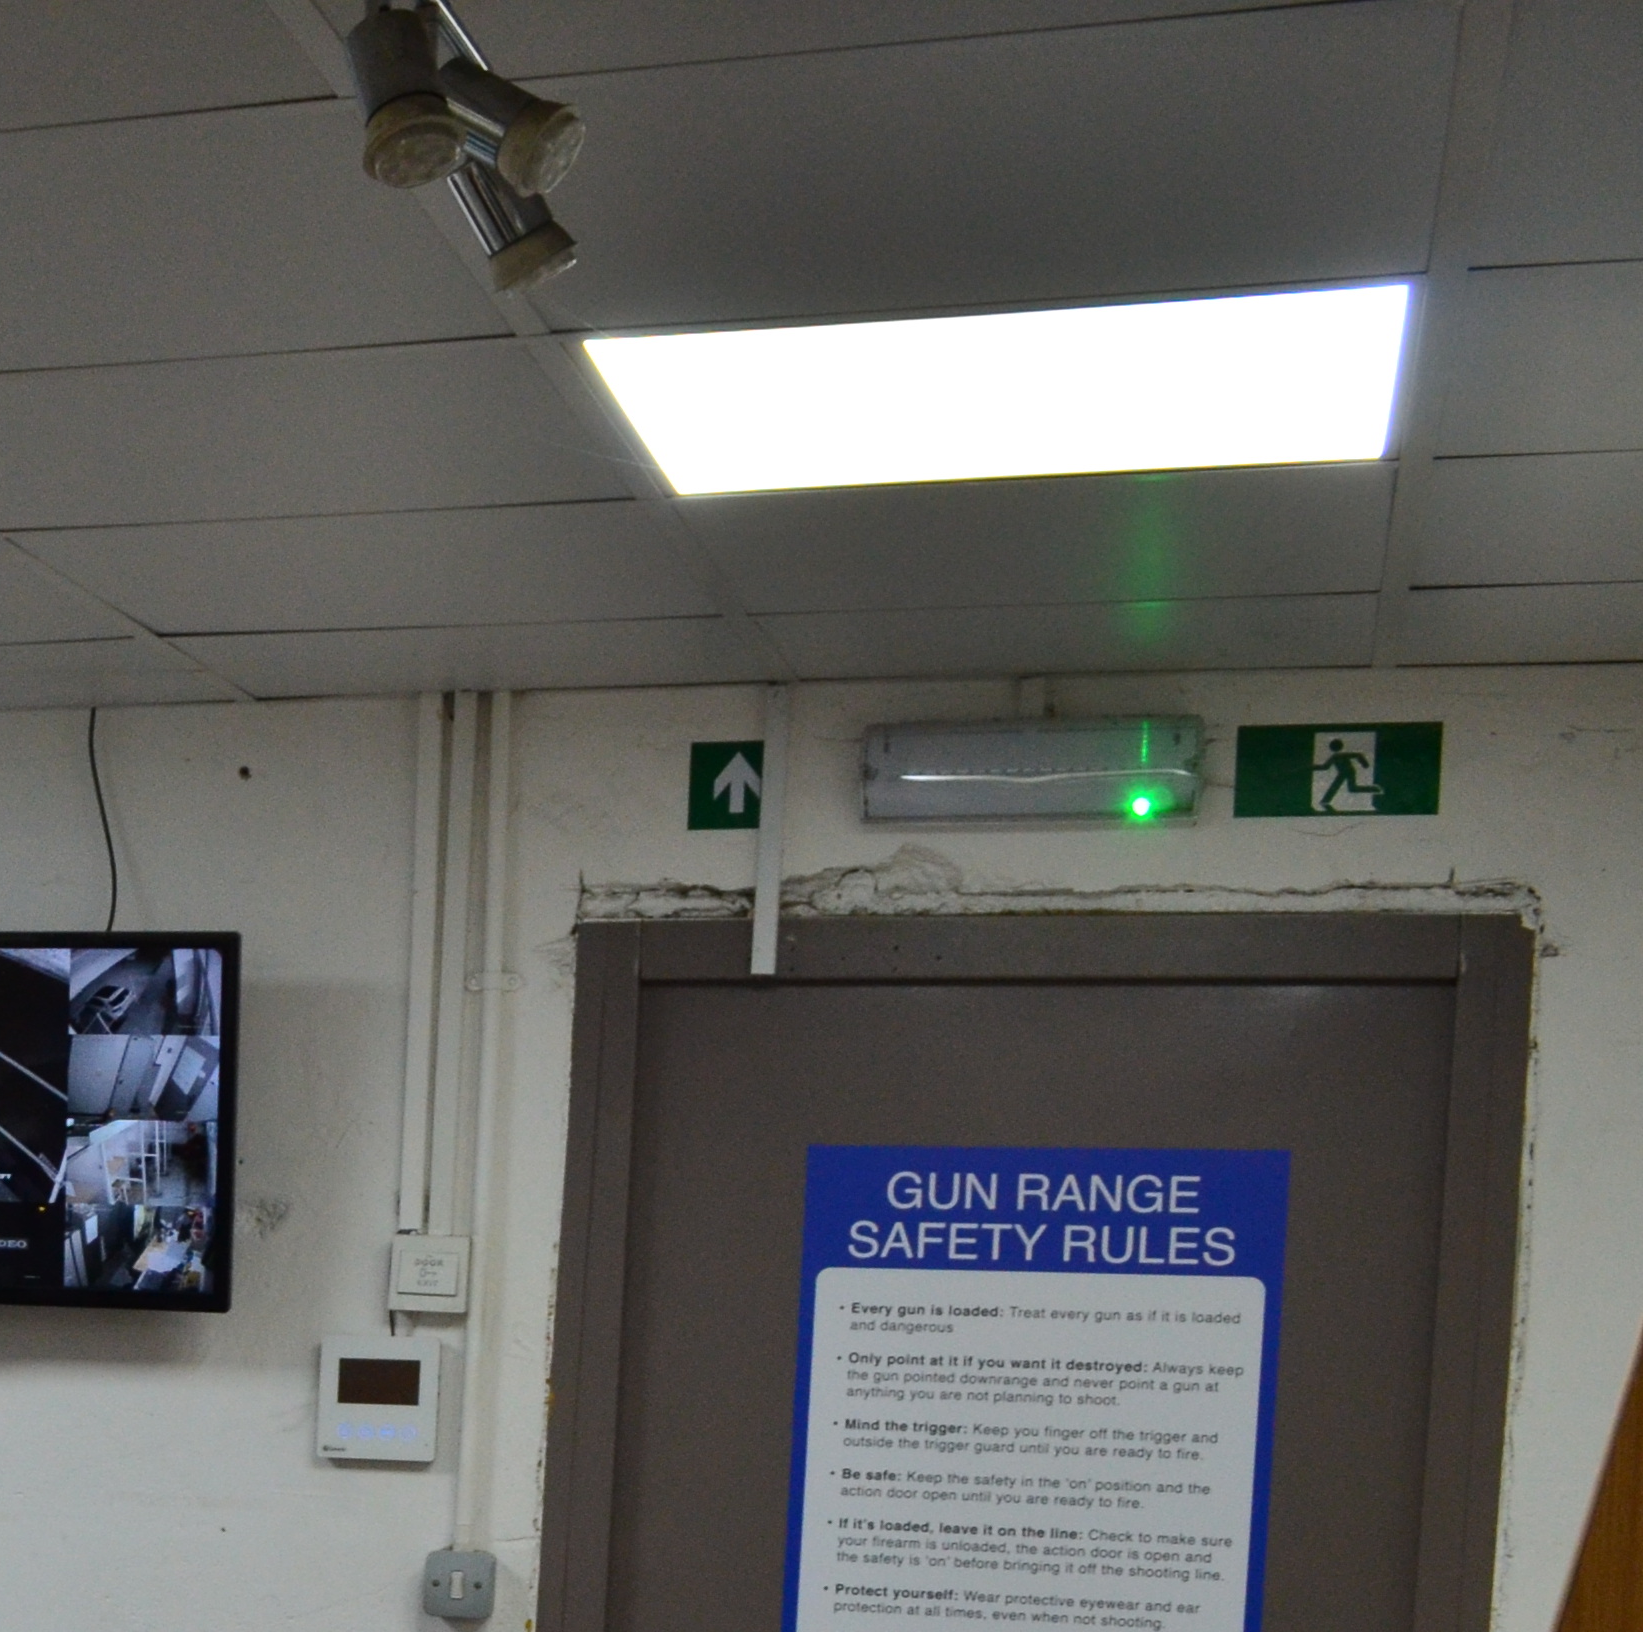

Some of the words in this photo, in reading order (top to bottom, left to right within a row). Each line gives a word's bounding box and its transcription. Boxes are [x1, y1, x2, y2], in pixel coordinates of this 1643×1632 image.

[886, 1171, 998, 1211] GUN
[1016, 1173, 1201, 1215] RANGE
[847, 1219, 1048, 1261] SAFETY
[1062, 1226, 1237, 1267] RULES
[850, 1302, 893, 1315] Every
[897, 1306, 925, 1316] gun
[930, 1305, 944, 1315] is
[1008, 1307, 1045, 1317] Treat
[1049, 1310, 1089, 1320] every
[1094, 1311, 1121, 1321] gun
[1126, 1312, 1143, 1320] as
[1147, 1310, 1157, 1320] if
[1161, 1310, 1170, 1321] it
[1174, 1311, 1187, 1321] is
[1191, 1311, 1241, 1323] loaded
[849, 1319, 876, 1330] and
[879, 1320, 954, 1334] dangerous
[847, 1353, 882, 1365] Only
[886, 1354, 925, 1367] point
[929, 1355, 944, 1365] at
[948, 1356, 958, 1366] it
[963, 1356, 973, 1366] if
[977, 1359, 1005, 1369] you
[1009, 1357, 1046, 1368] want
[1051, 1359, 1061, 1369] it
[1151, 1362, 1204, 1375] Always
[1208, 1364, 1244, 1377] keep
[844, 1418, 880, 1429] Mind
[884, 1420, 908, 1430] the
[972, 1423, 1009, 1436] Keep
[1013, 1427, 1039, 1437] you
[1043, 1426, 1085, 1439] finger
[1089, 1427, 1107, 1438] off
[1111, 1428, 1135, 1439] the
[1138, 1429, 1187, 1443] trigger
[1191, 1431, 1218, 1442] and
[834, 1583, 888, 1596] Protect
[963, 1590, 1000, 1602] Wear
[1004, 1592, 1075, 1608] protective
[1079, 1598, 1140, 1611] eyewear
[1144, 1600, 1172, 1611] and
[1176, 1604, 1200, 1613] ear
